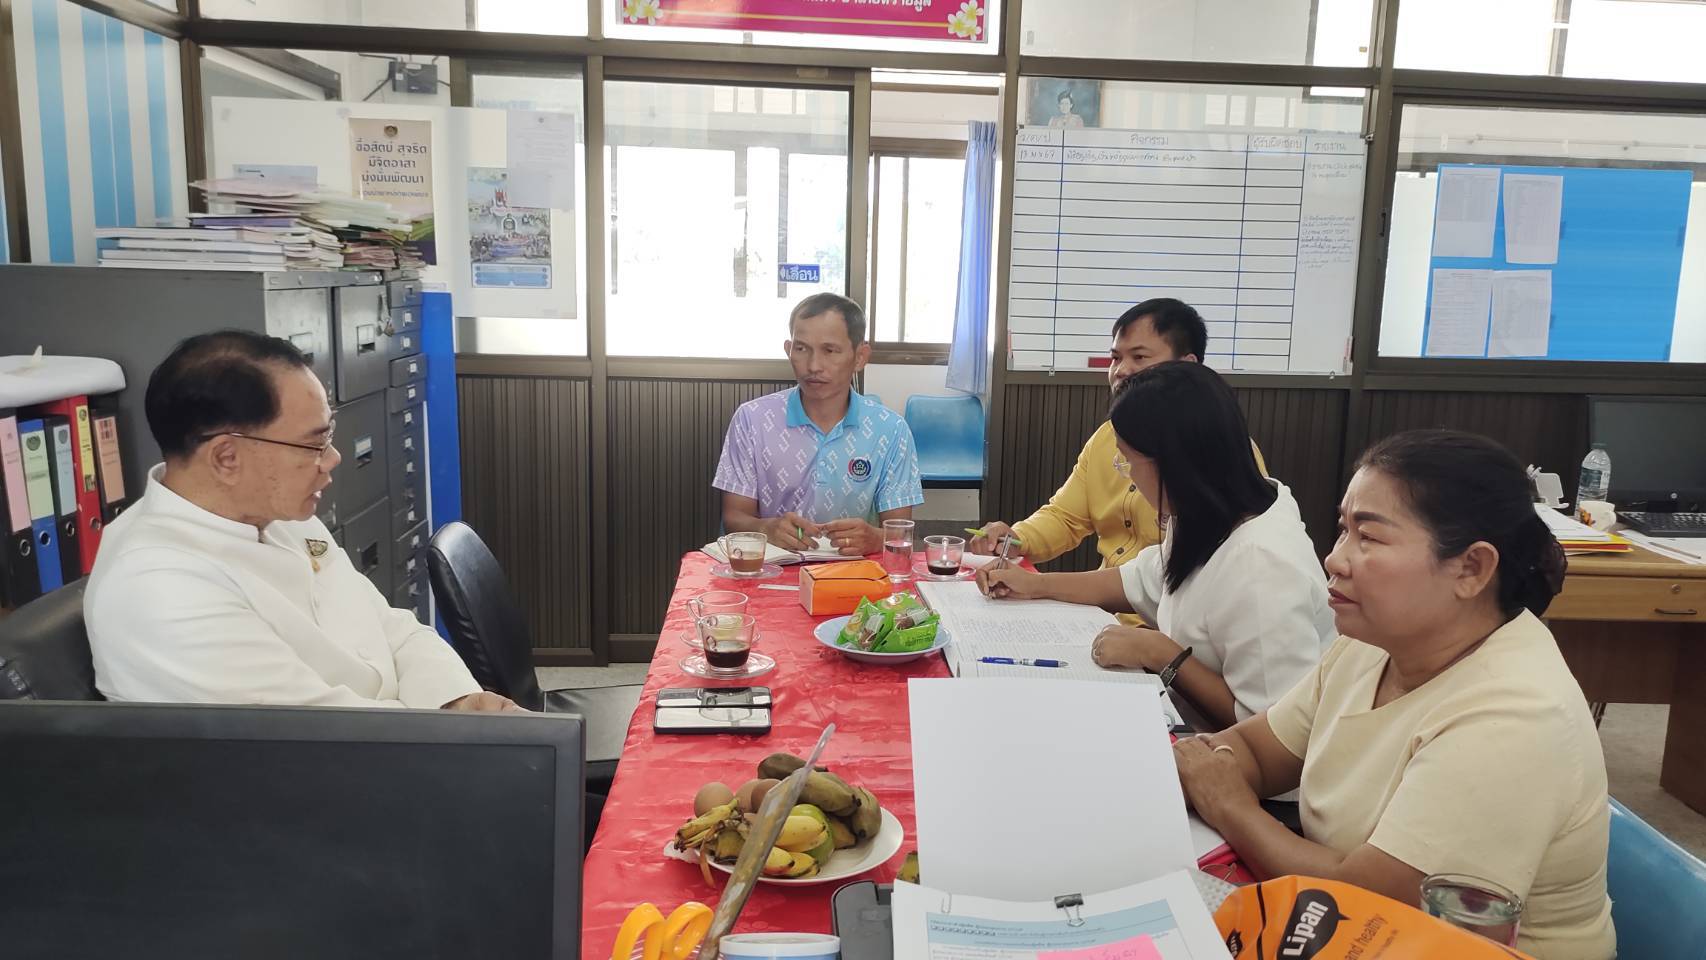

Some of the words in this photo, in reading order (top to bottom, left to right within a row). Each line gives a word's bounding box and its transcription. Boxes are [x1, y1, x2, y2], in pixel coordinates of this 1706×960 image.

[355, 137, 393, 152] ซื่อสัตย์
[397, 142, 427, 156] สุจริต
[368, 155, 416, 168] มีจิตอาสา
[361, 170, 424, 185] มุ่งมั่นพัฒนา
[1283, 901, 1329, 956] Lipan
